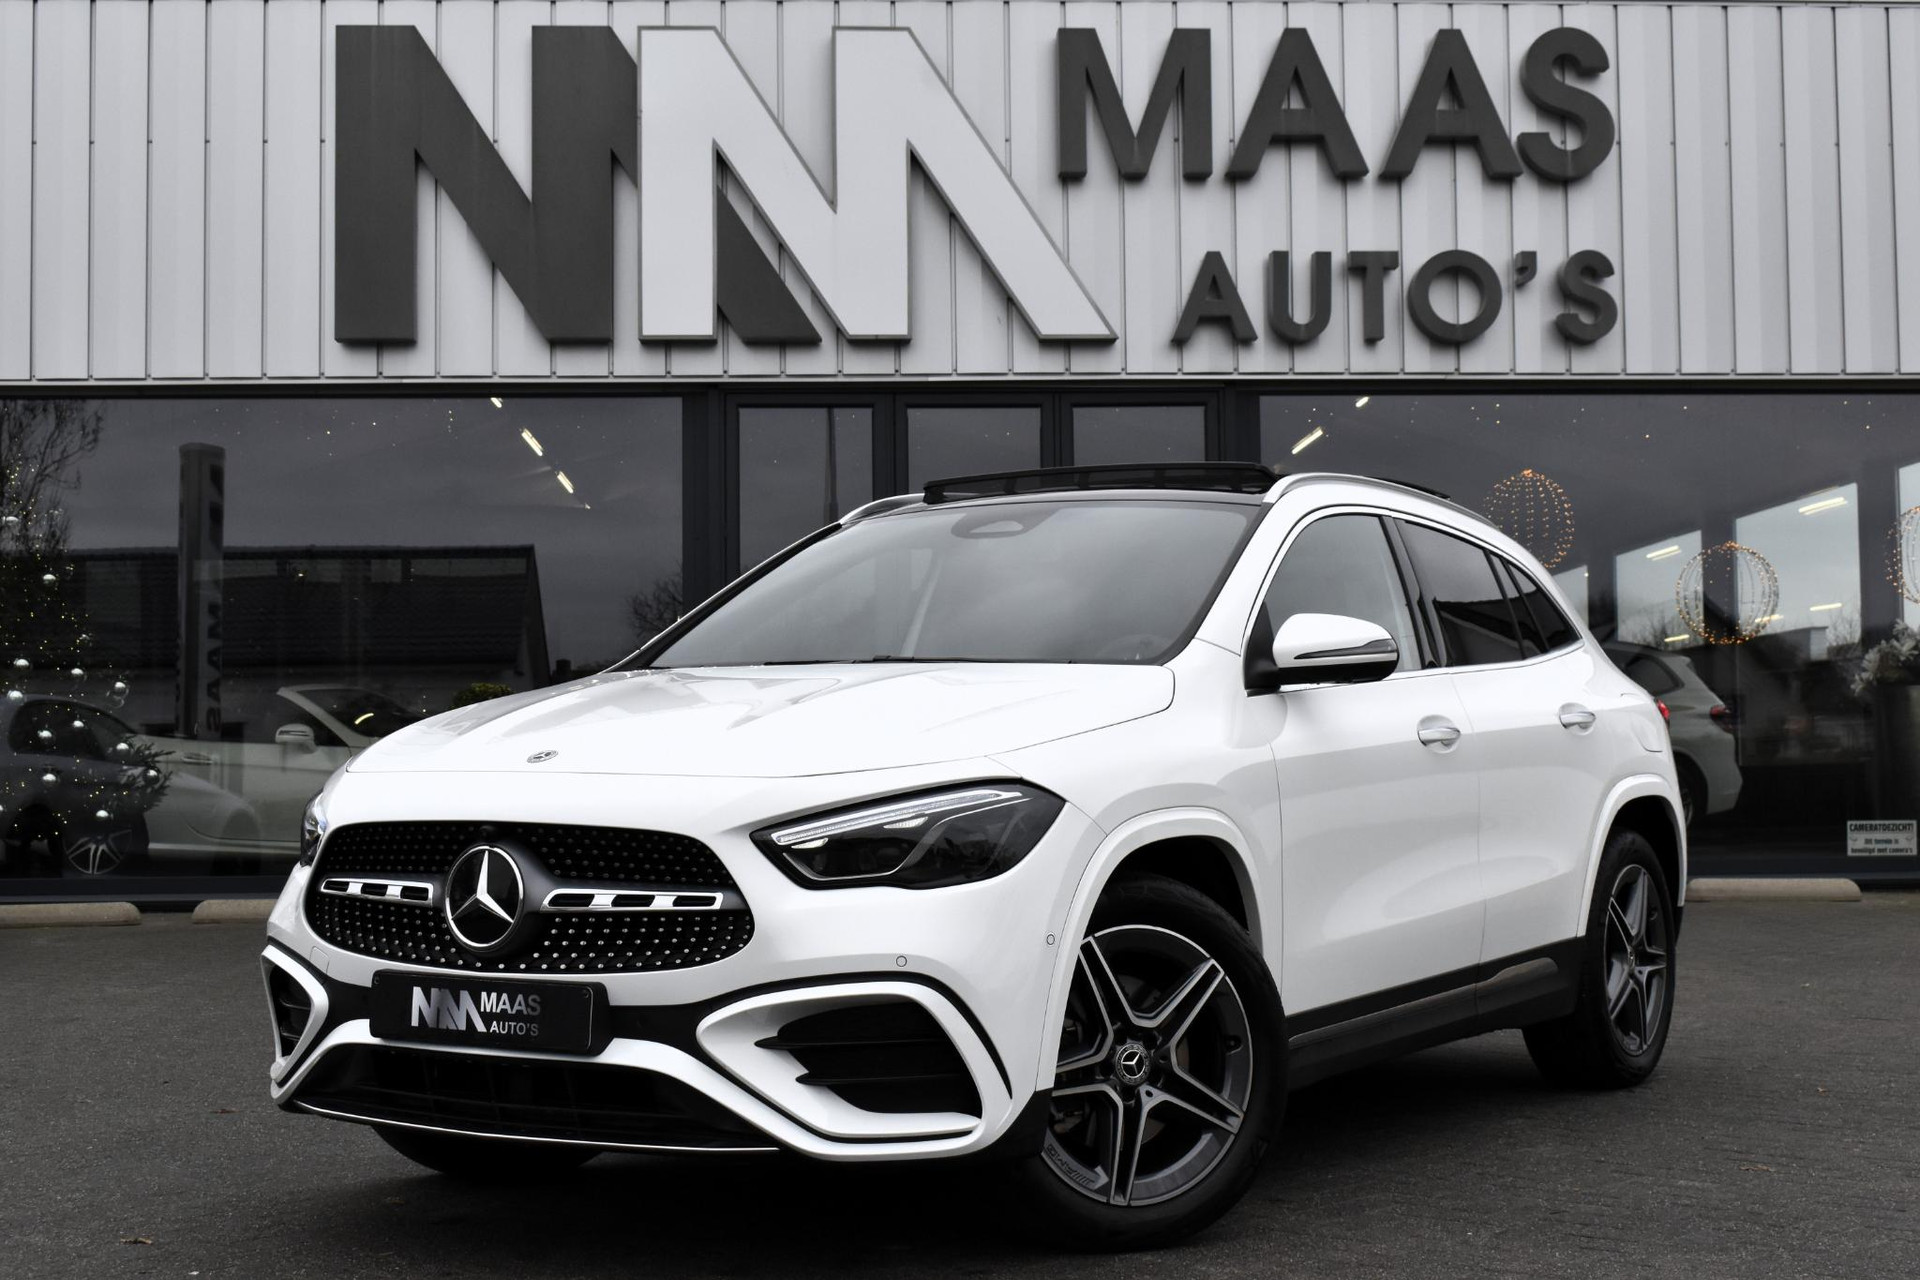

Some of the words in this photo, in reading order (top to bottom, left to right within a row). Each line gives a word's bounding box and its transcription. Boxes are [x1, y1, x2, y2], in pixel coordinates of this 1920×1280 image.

[1057, 26, 1616, 183] MAAS
[1170, 249, 1619, 346] AUTO'S
[480, 991, 541, 1016] MAAS
[489, 1021, 539, 1037] AUTO'S
